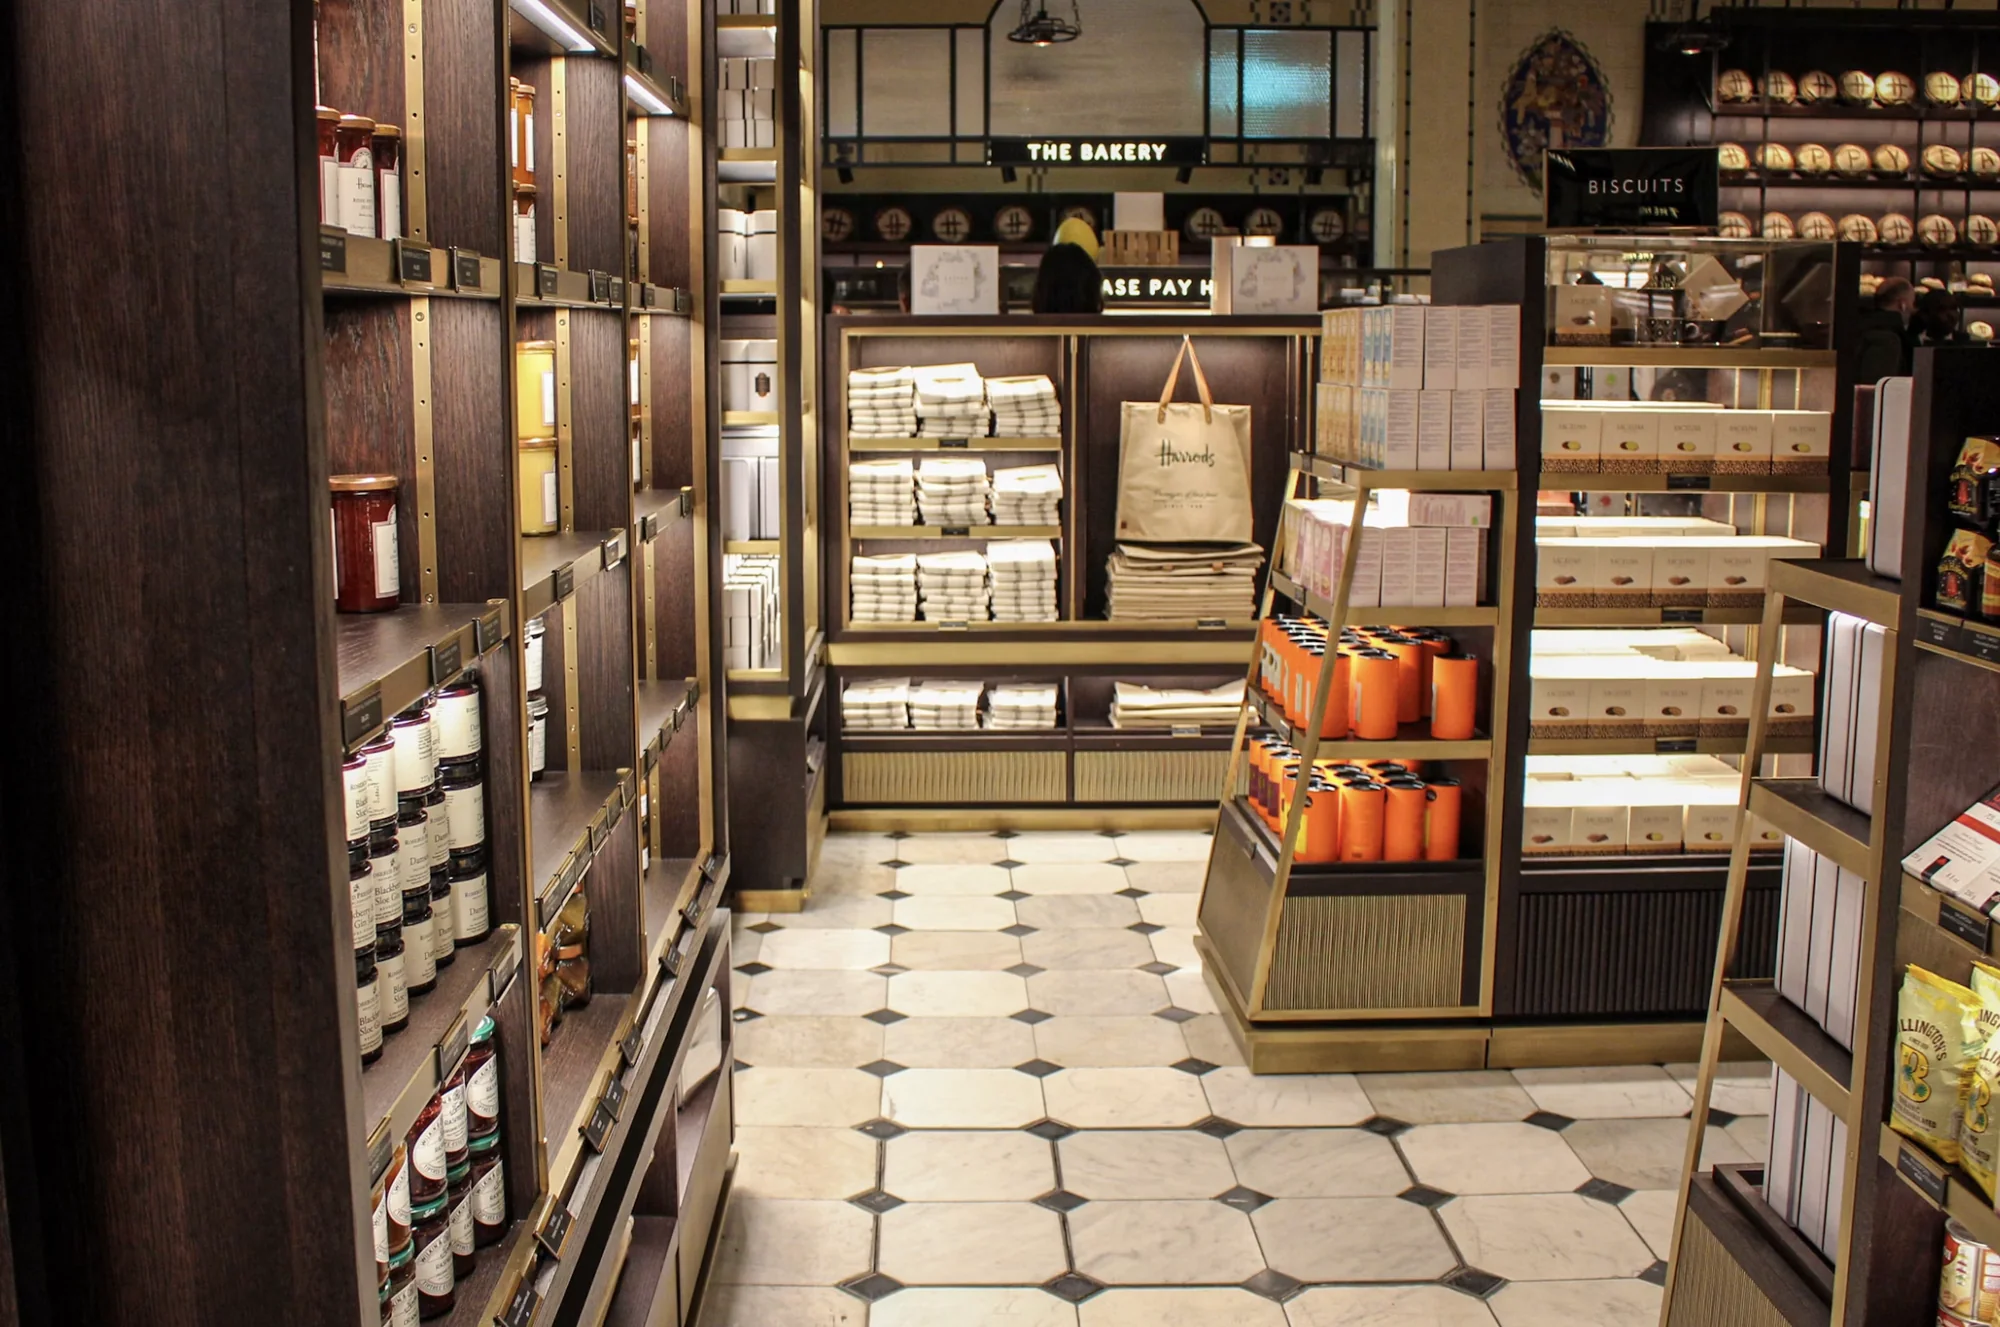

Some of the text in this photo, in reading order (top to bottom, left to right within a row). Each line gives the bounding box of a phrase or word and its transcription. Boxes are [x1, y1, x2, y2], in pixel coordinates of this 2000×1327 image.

[1027, 143, 1167, 161] THE BAKERY
[1588, 178, 1684, 194] BISCUITS
[1101, 278, 1141, 296] ASE
[1149, 278, 1192, 296] PAY
[1154, 439, 1215, 467] Harrods
[1900, 1018, 1947, 1062] LLINGTON'S
